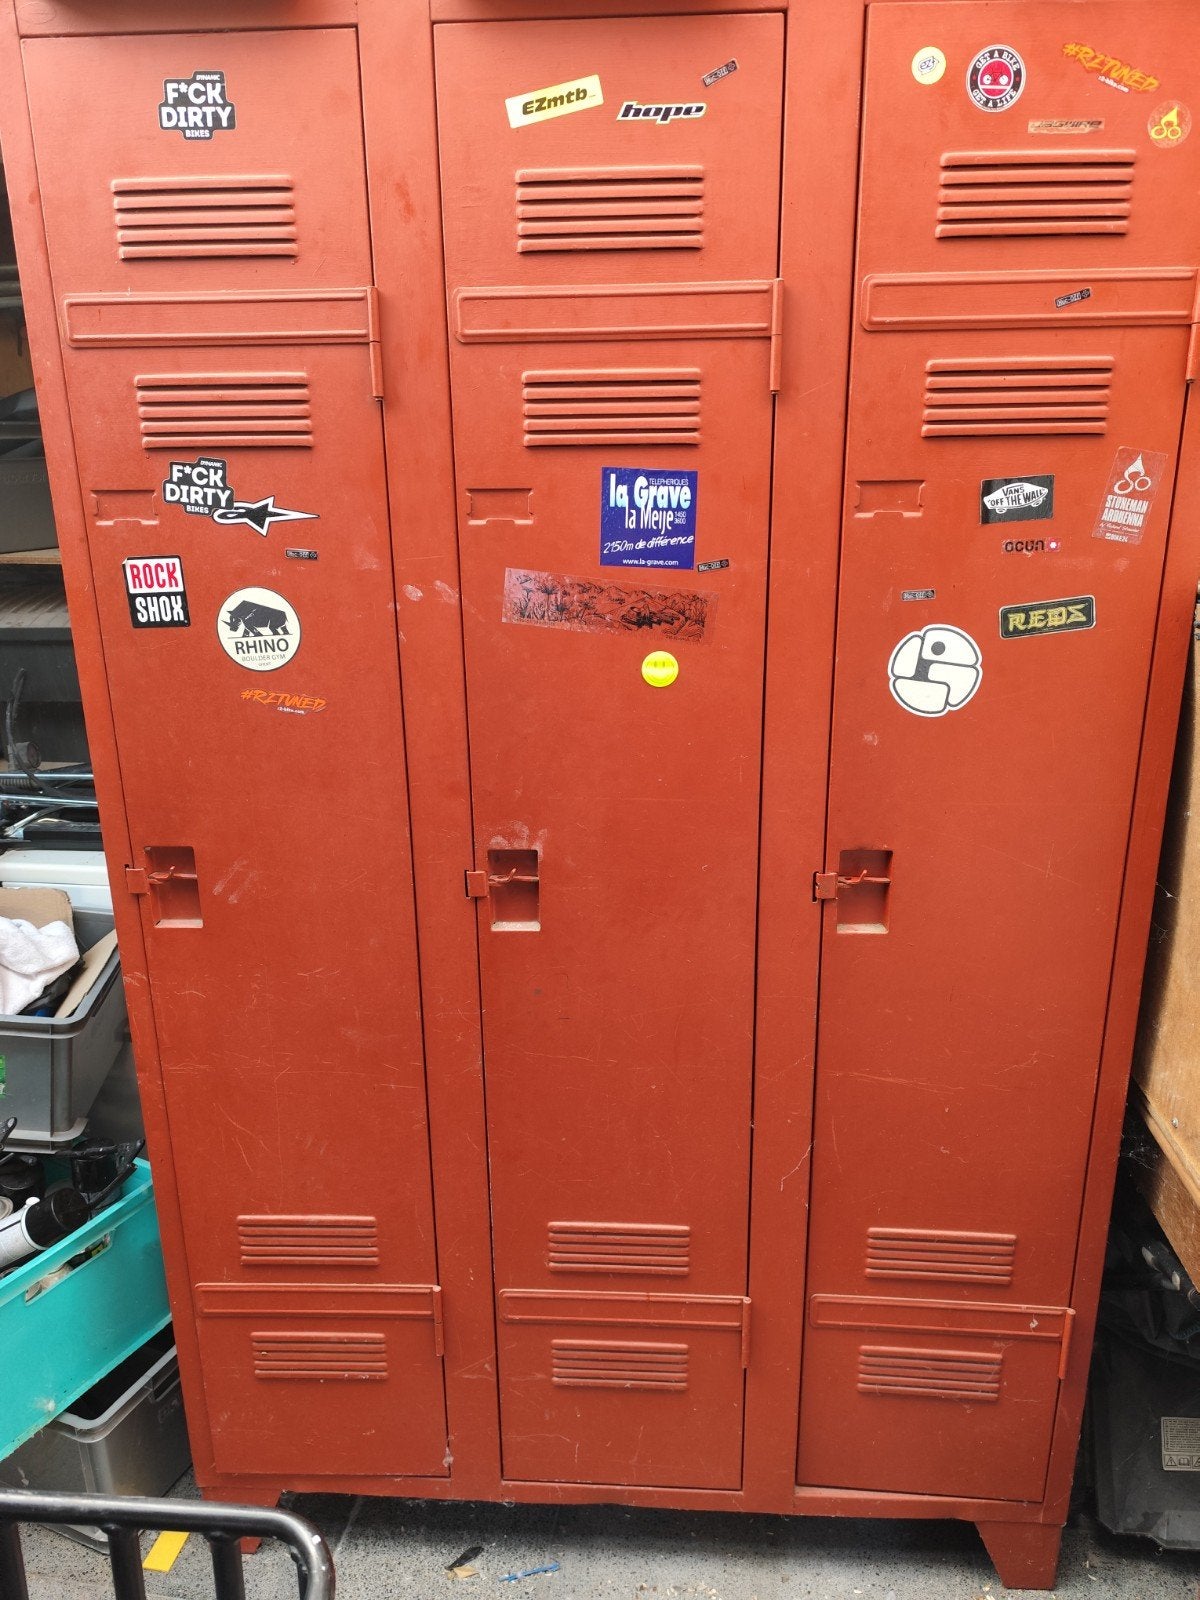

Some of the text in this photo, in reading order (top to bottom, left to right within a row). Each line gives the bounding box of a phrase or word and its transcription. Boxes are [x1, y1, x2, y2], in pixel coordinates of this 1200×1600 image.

[976, 50, 1020, 71] GET A BIKE
[522, 87, 588, 116] EZmtb
[973, 89, 987, 104] GET
[997, 89, 1017, 107] LIFE
[161, 106, 232, 128] DIRTY
[621, 103, 705, 121] hope
[185, 129, 210, 138] BIKES
[165, 483, 232, 507] DIRTY
[609, 473, 692, 509] la Grave
[1002, 484, 1025, 496] VANS
[186, 504, 209, 514] BIKES
[1006, 494, 1022, 506] THE
[1105, 495, 1149, 514] STONEMAN
[625, 500, 674, 534] la Meije
[603, 535, 695, 554] 2150m de différence
[623, 558, 679, 567] www.la-grave.com
[129, 562, 180, 589] ROCK
[135, 595, 185, 623] SHOX
[1007, 603, 1088, 632] REDS
[234, 638, 289, 656] RHINO
[242, 653, 287, 662] BOULDER GYM
